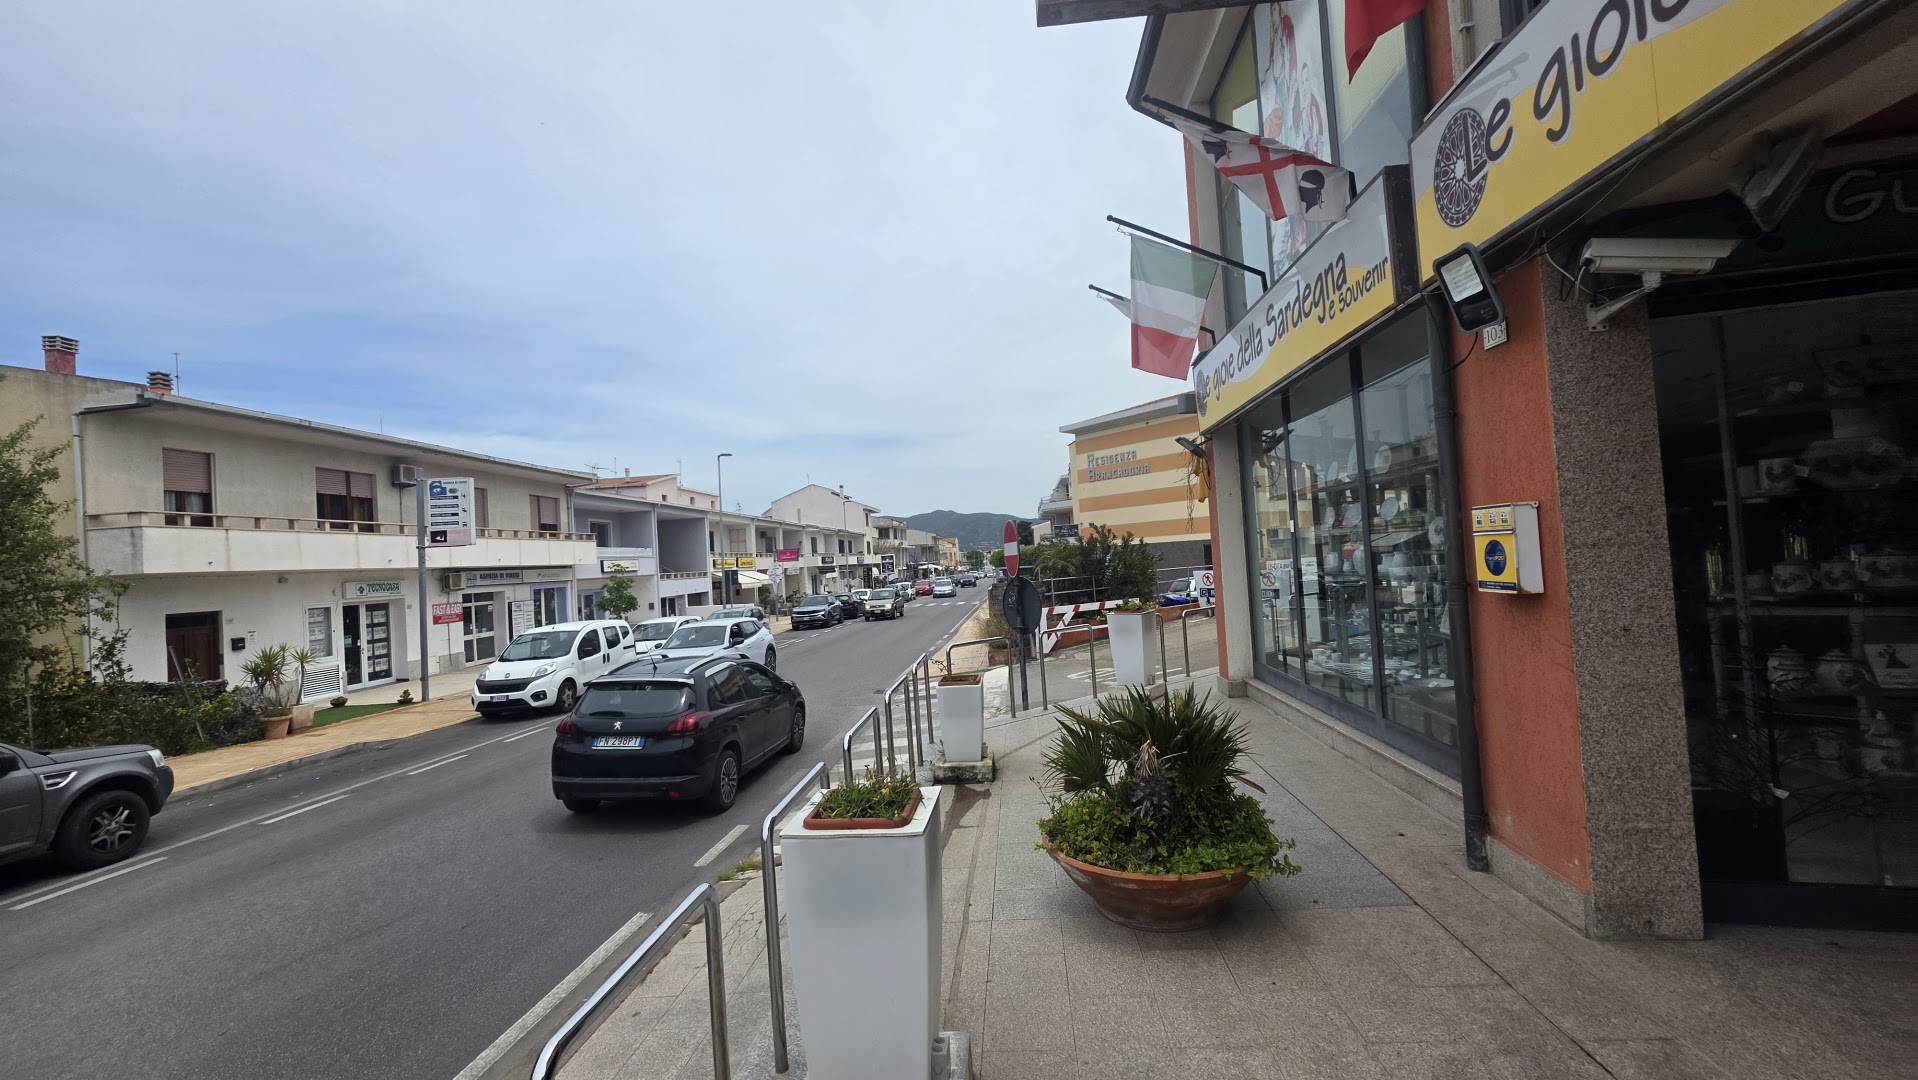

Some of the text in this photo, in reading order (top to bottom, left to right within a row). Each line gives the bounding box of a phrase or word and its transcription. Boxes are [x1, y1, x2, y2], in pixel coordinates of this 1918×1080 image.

[1461, 97, 1514, 183] Le
[1329, 256, 1389, 320] e souvenir
[1213, 353, 1235, 401] gioie
[1237, 322, 1263, 373] della
[1266, 252, 1348, 347] Sardegna
[1486, 325, 1504, 343] 103
[367, 583, 400, 593] TECNOCASA
[433, 603, 463, 615] FAST & EASY
[599, 736, 610, 746] FN
